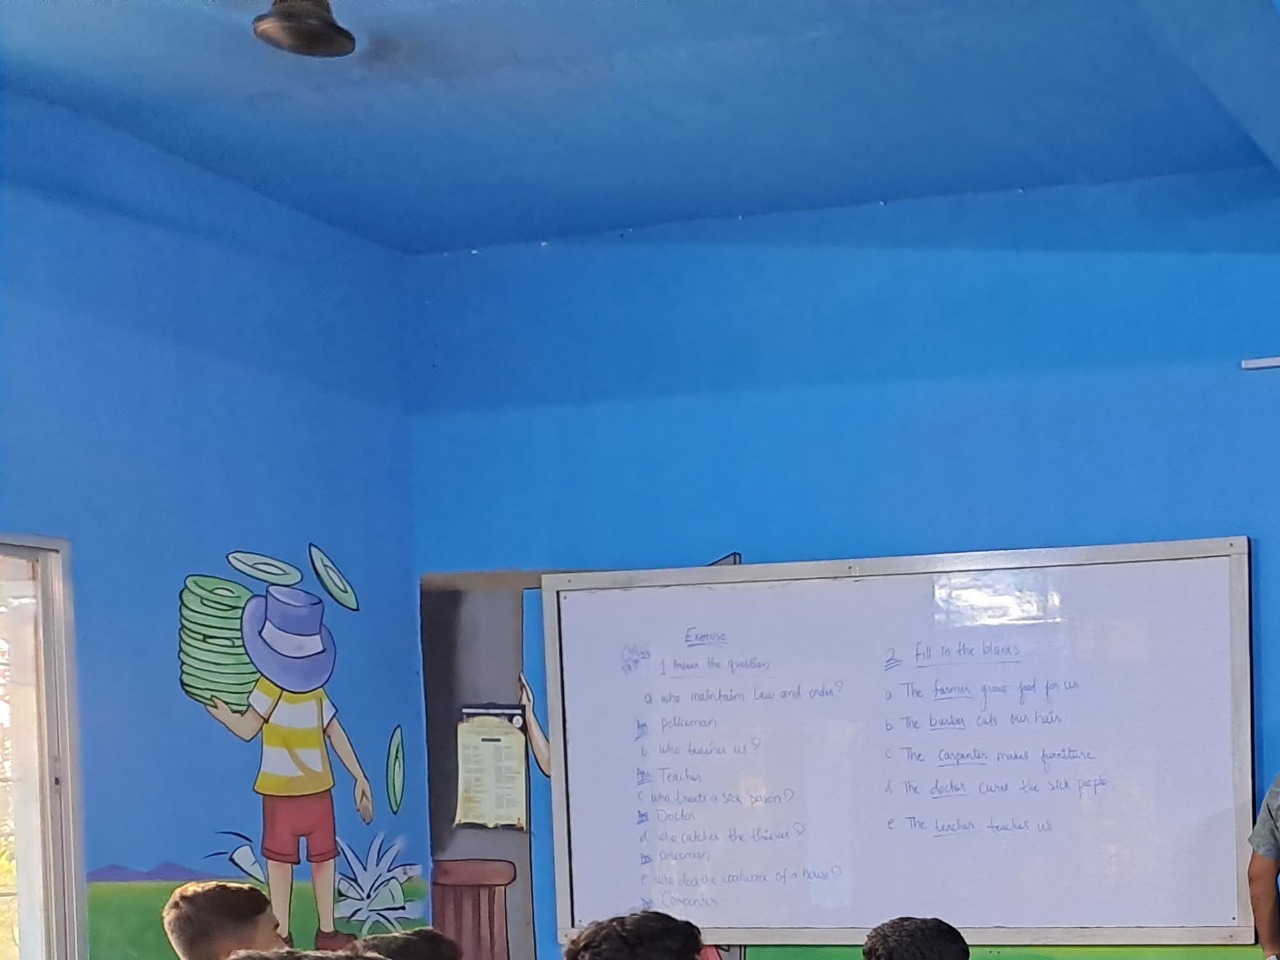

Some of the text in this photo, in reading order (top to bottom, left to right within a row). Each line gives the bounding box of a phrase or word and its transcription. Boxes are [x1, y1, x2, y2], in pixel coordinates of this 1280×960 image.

[941, 645, 951, 657] in
[956, 642, 975, 657] the
[707, 657, 721, 669] the
[644, 694, 653, 704] a
[780, 685, 801, 698] and
[885, 690, 892, 701] a
[901, 682, 923, 698] The
[934, 680, 971, 697] farmer
[1045, 680, 1060, 703] for
[1065, 680, 1080, 691] us
[885, 720, 893, 731] b
[901, 716, 920, 730] The
[1010, 713, 1029, 725] our
[900, 747, 924, 762] The
[1041, 746, 1095, 773] furniture
[902, 780, 920, 795] The
[1019, 779, 1040, 793] the
[711, 795, 719, 803] a
[656, 809, 696, 822] Doctor
[905, 816, 927, 830] The
[728, 827, 744, 842] the
